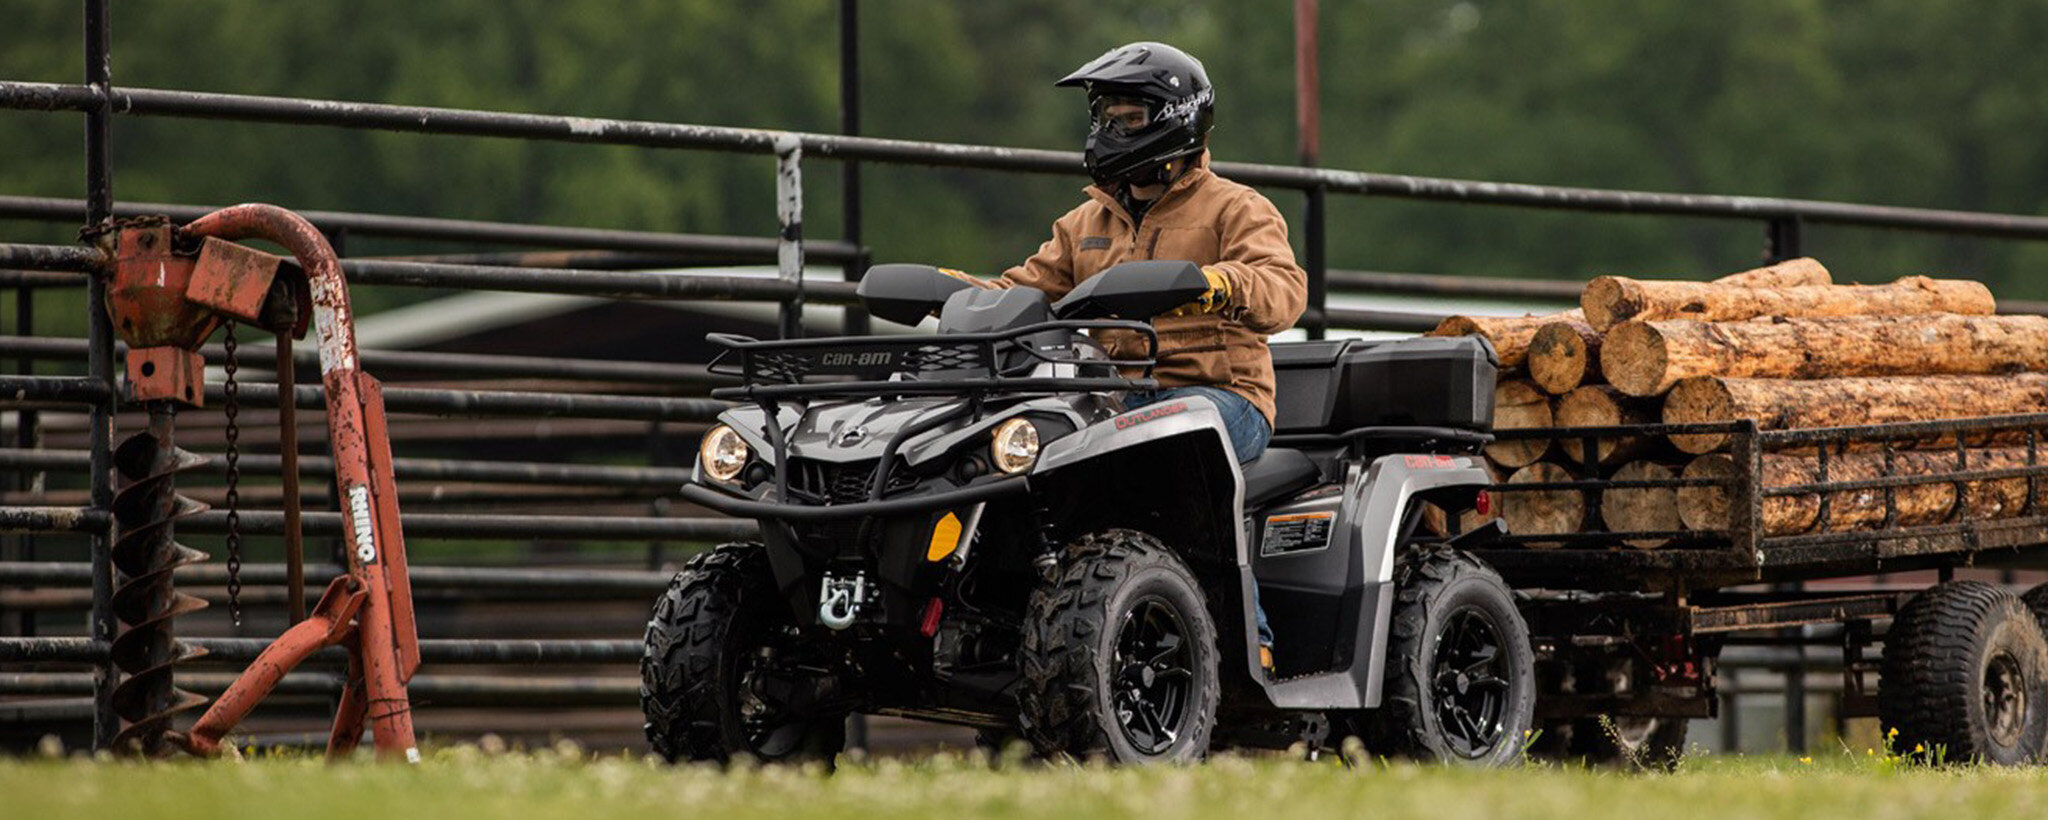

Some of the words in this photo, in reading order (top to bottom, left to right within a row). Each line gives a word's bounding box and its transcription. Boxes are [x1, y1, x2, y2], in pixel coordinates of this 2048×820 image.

[821, 351, 892, 366] can-am
[1115, 402, 1188, 430] OUTLANDER
[348, 486, 376, 562] RHINO
